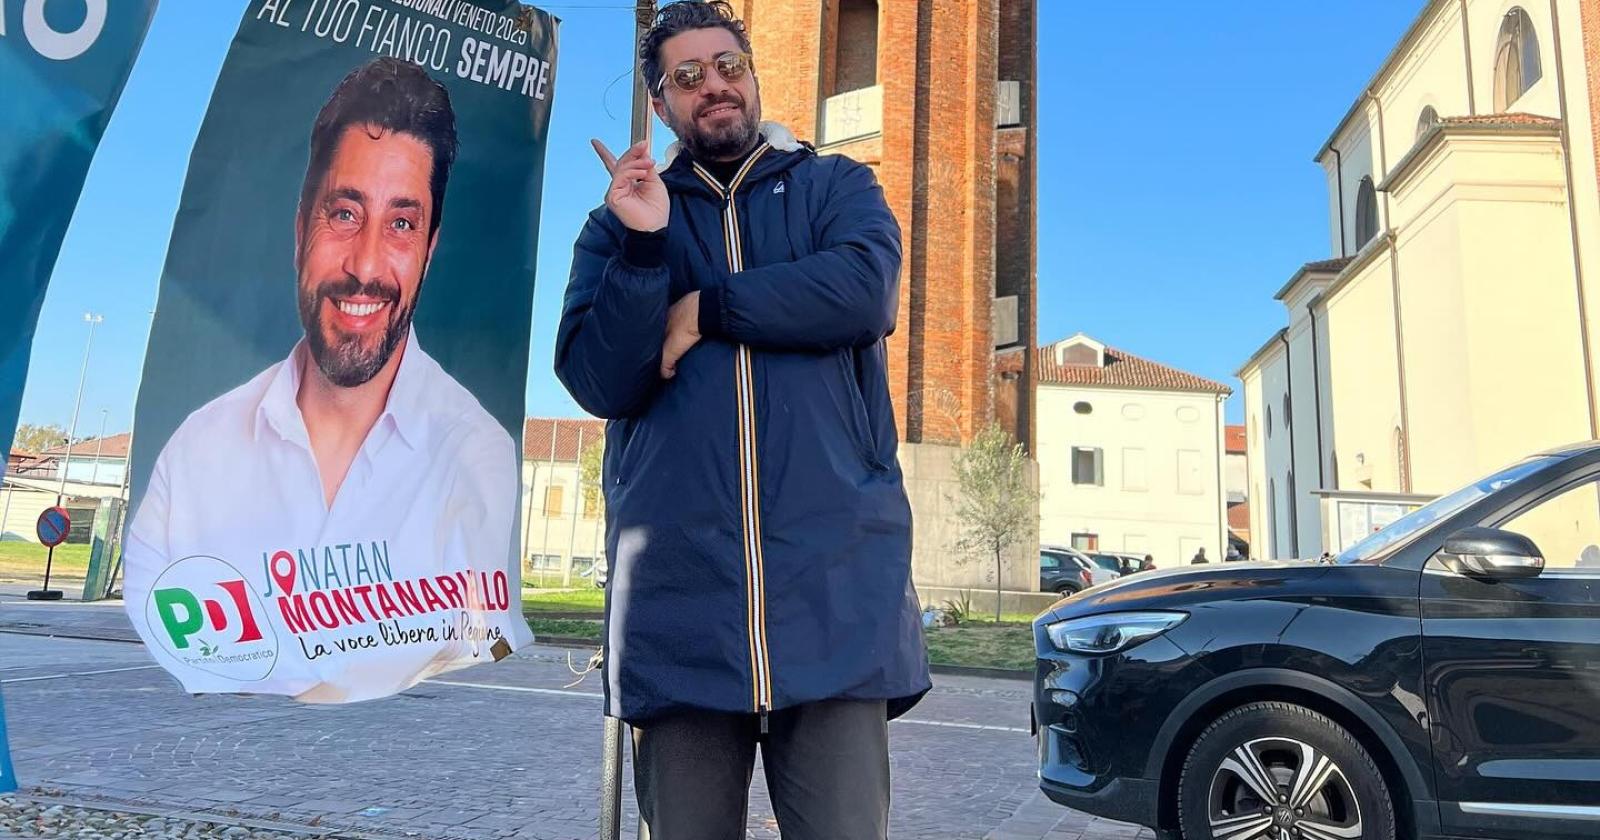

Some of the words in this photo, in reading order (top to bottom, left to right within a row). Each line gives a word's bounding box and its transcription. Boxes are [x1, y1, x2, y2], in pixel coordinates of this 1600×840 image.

[0, 0, 108, 60] O
[355, 4, 451, 73] FIANCO.
[456, 37, 550, 101] SEMPRE
[452, 1, 496, 35] VENETO
[495, 16, 527, 46] 2025
[277, 569, 509, 634] MONTANARILO
[333, 634, 379, 653] voce
[378, 620, 440, 646] libera
[442, 618, 459, 641] in
